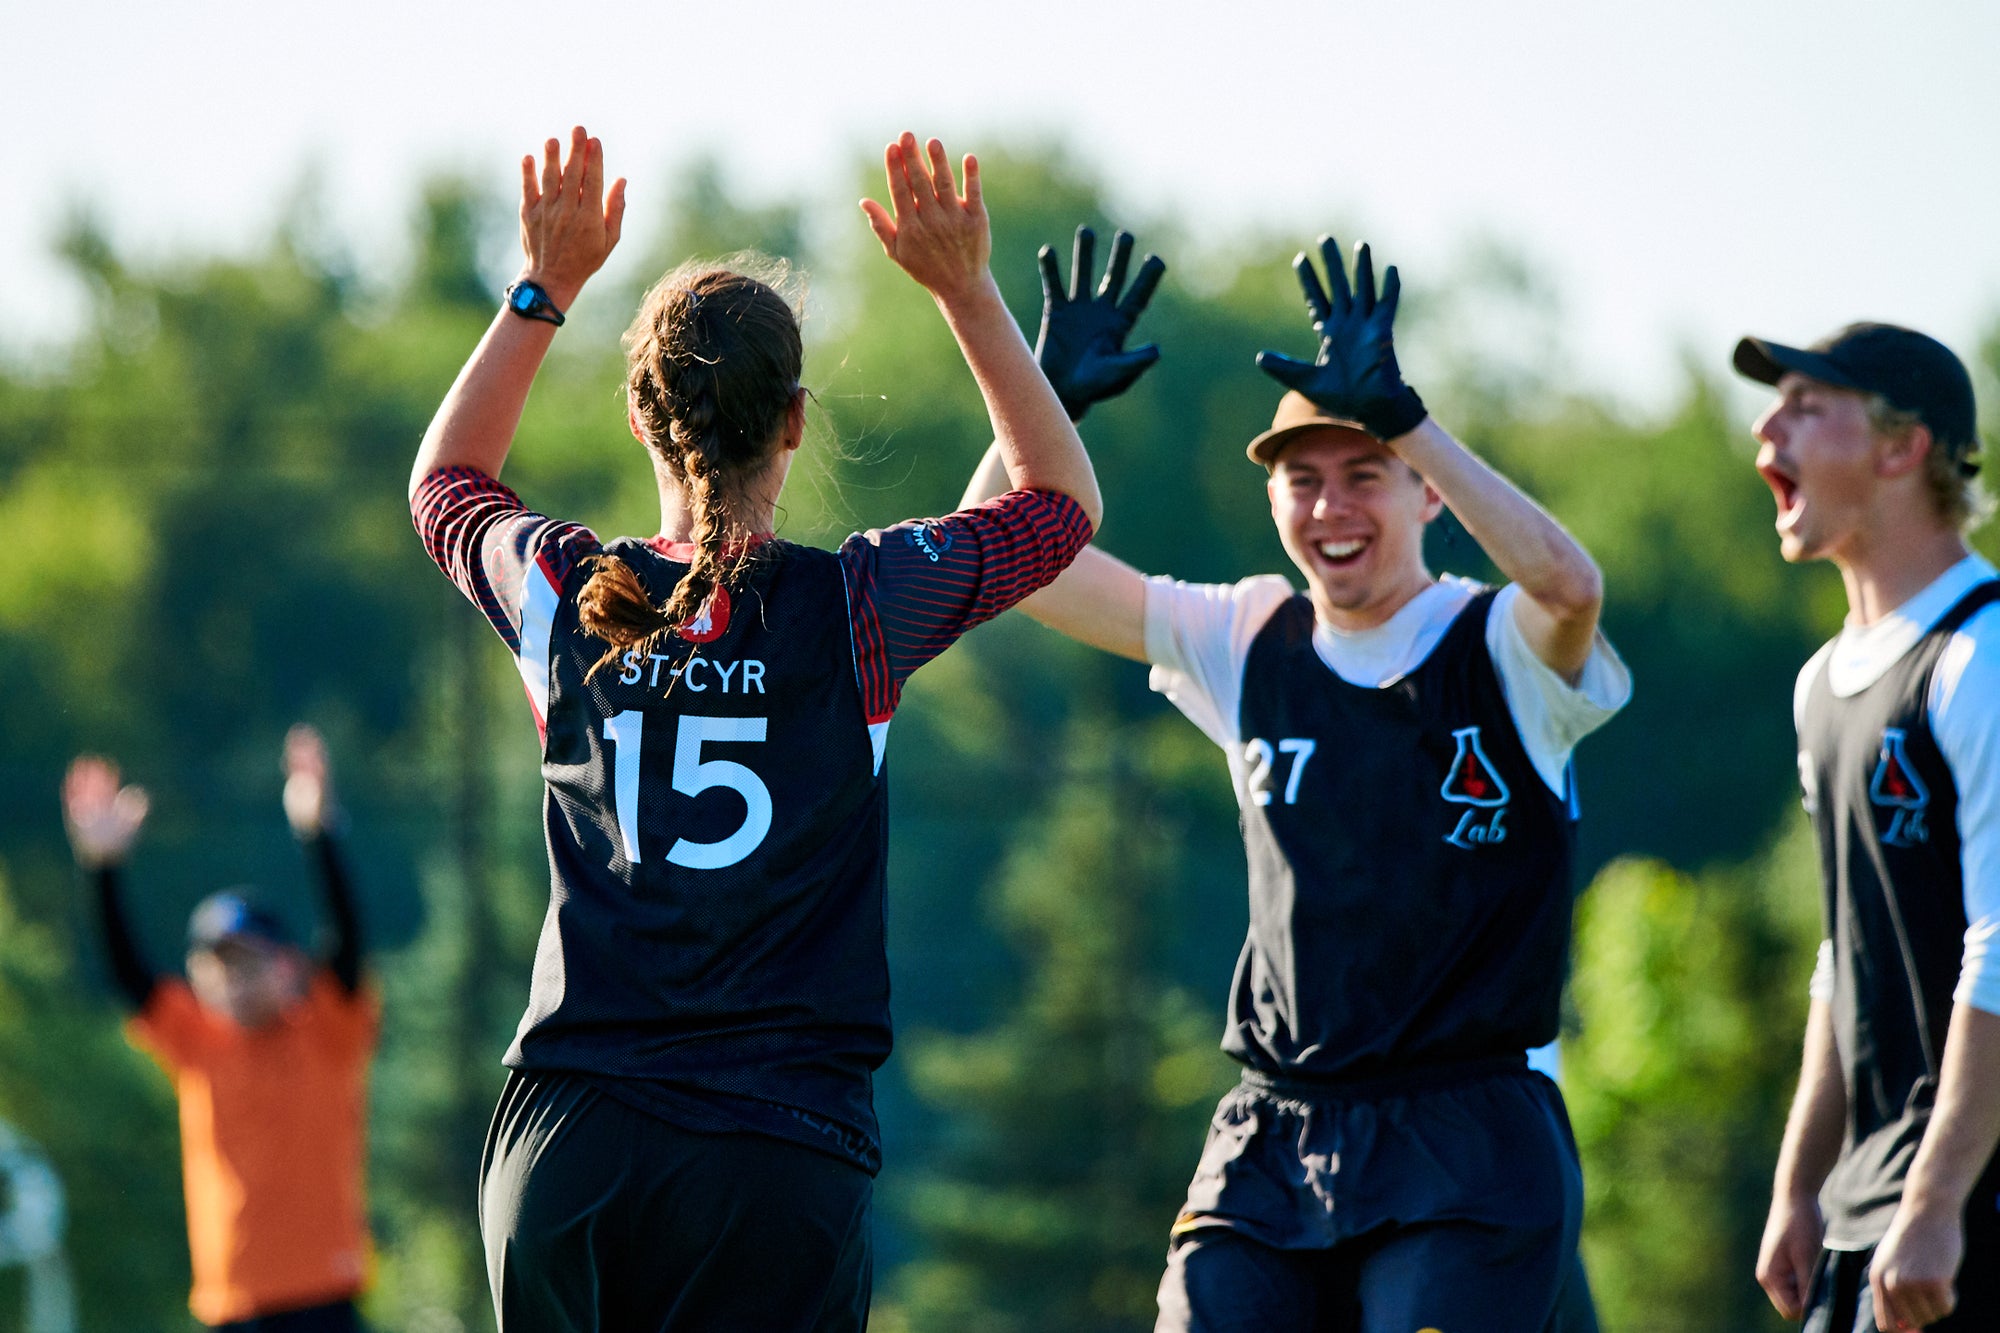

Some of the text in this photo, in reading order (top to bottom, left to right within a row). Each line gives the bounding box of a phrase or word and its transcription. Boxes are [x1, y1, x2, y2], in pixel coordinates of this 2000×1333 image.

[619, 650, 766, 694] ST-CYR
[603, 709, 773, 870] 15
[1244, 737, 1317, 806] 27
[1440, 807, 1509, 852] Lab
